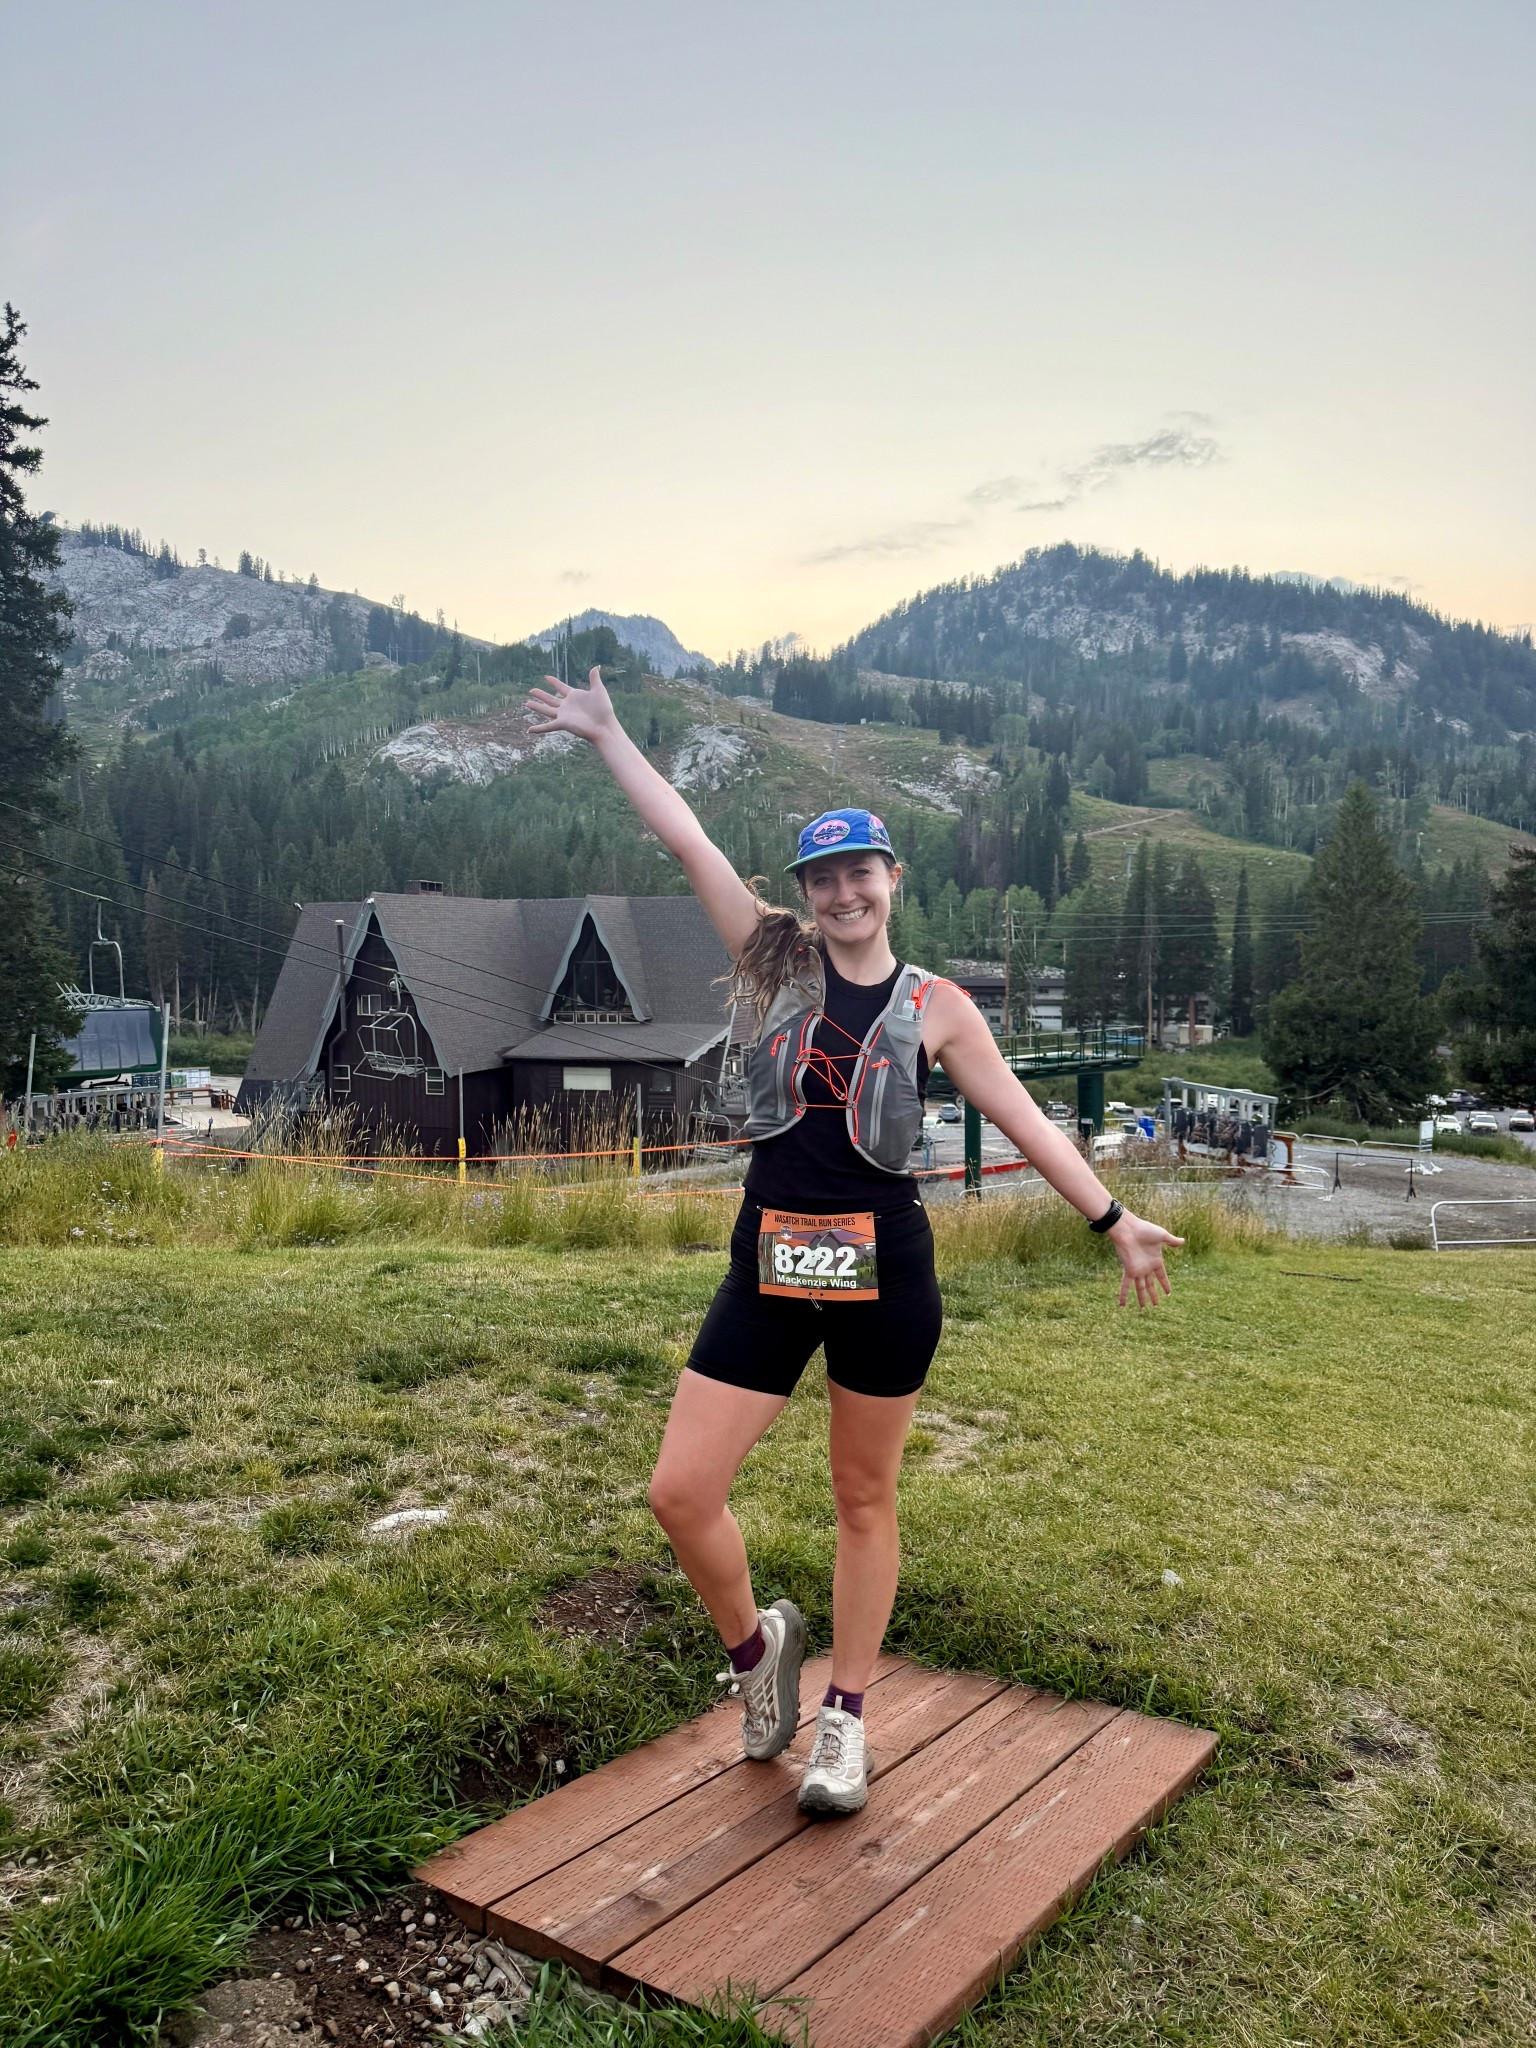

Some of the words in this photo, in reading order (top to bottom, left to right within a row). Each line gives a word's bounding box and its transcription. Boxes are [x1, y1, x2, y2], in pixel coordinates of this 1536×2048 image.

[774, 1213, 800, 1226] WASATCH
[801, 1217, 817, 1227] TRAIL
[818, 1218, 832, 1228] RUN
[833, 1216, 856, 1227] SERIES
[774, 1243, 858, 1277] 8222
[776, 1274, 828, 1287] Mackenzie
[829, 1278, 858, 1289] Wing
